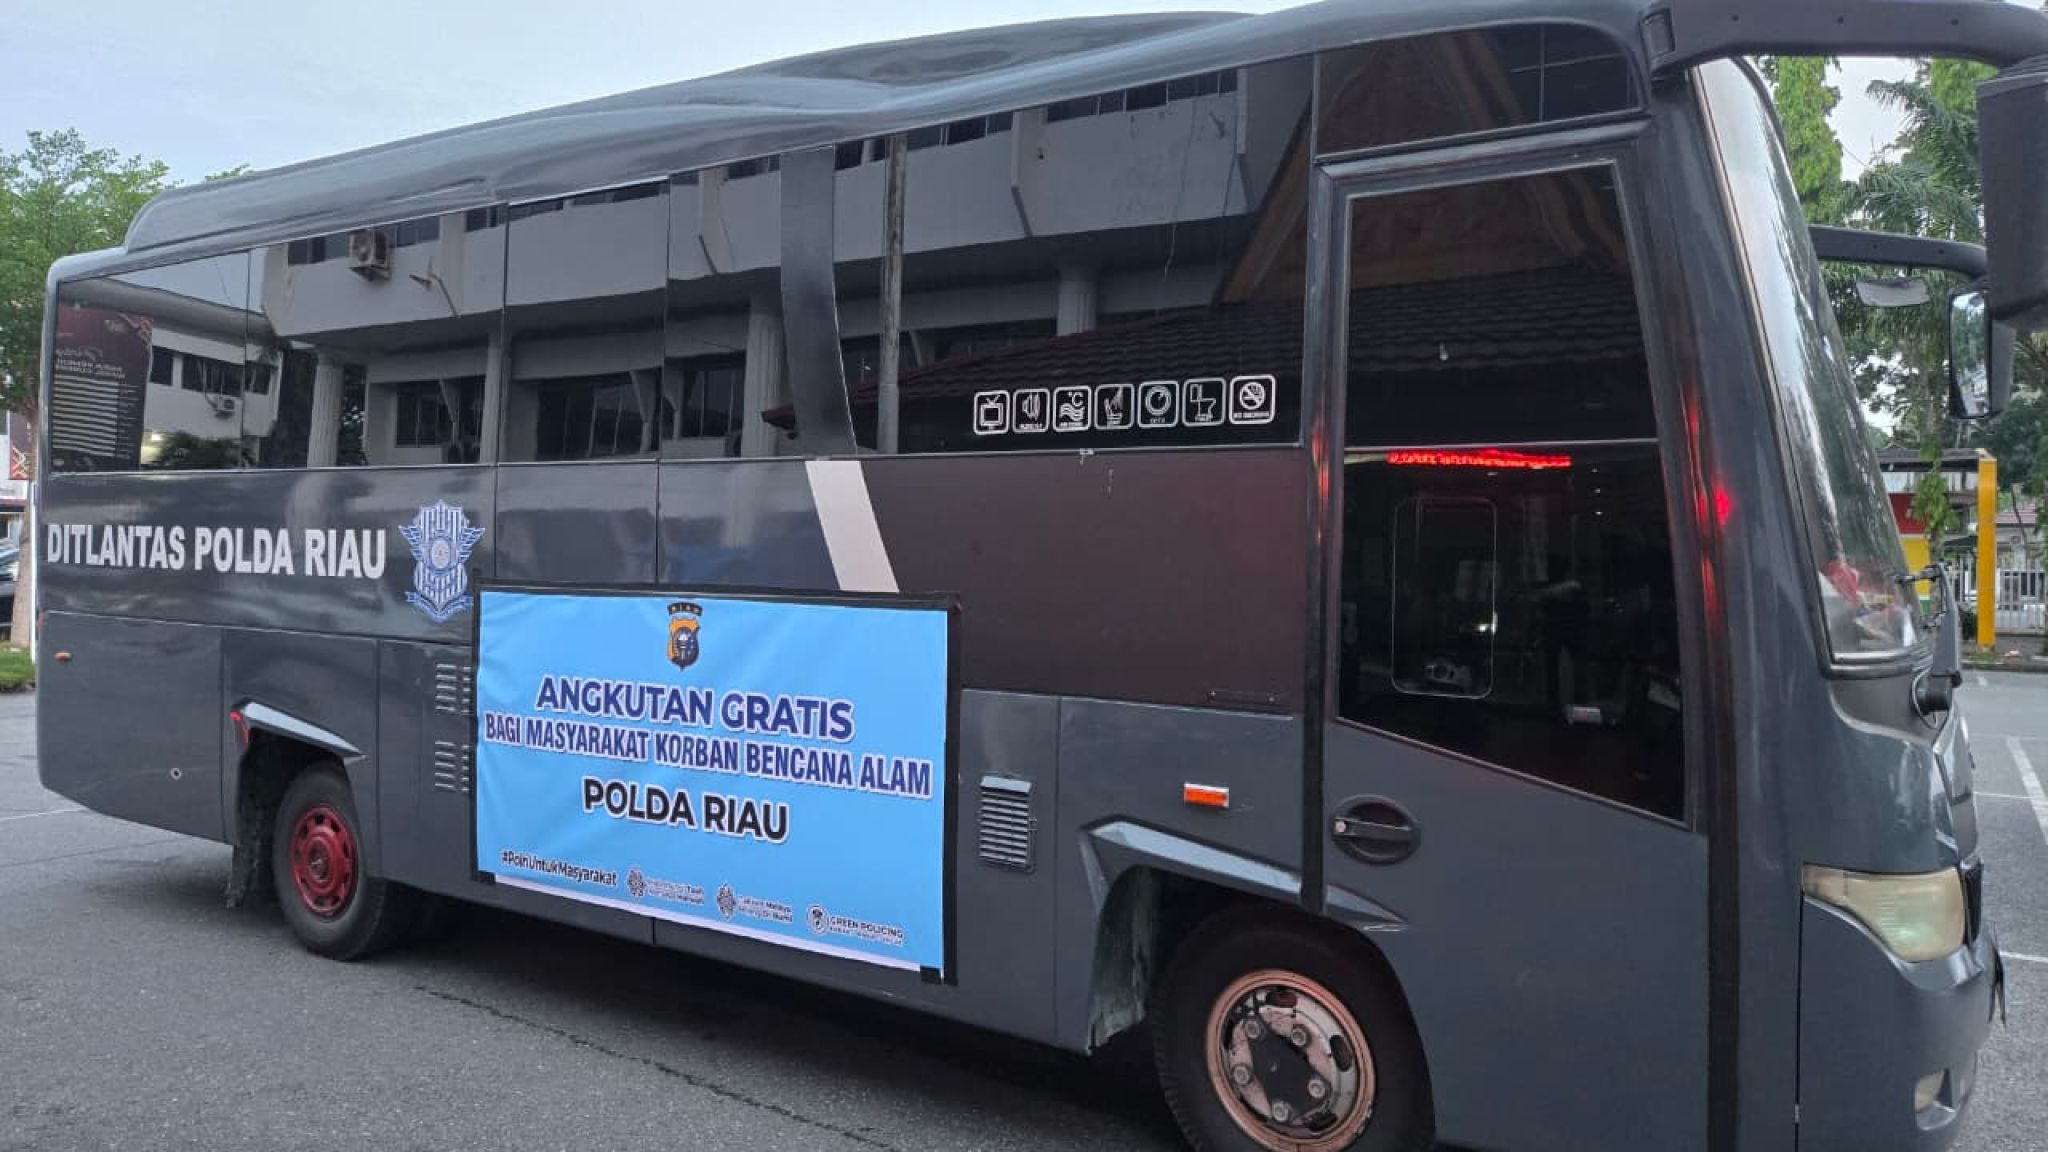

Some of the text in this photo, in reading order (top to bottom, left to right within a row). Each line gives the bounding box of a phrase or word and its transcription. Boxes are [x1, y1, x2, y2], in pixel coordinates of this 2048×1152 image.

[47, 524, 385, 579] DITLANTAS POLDA RIAU
[536, 675, 854, 741] ANGKUTAN GRATIS
[485, 713, 932, 796] BAGI MASYARAKAT KORBAN BENCANA ALAM
[583, 778, 789, 842] POLDA RIAU
